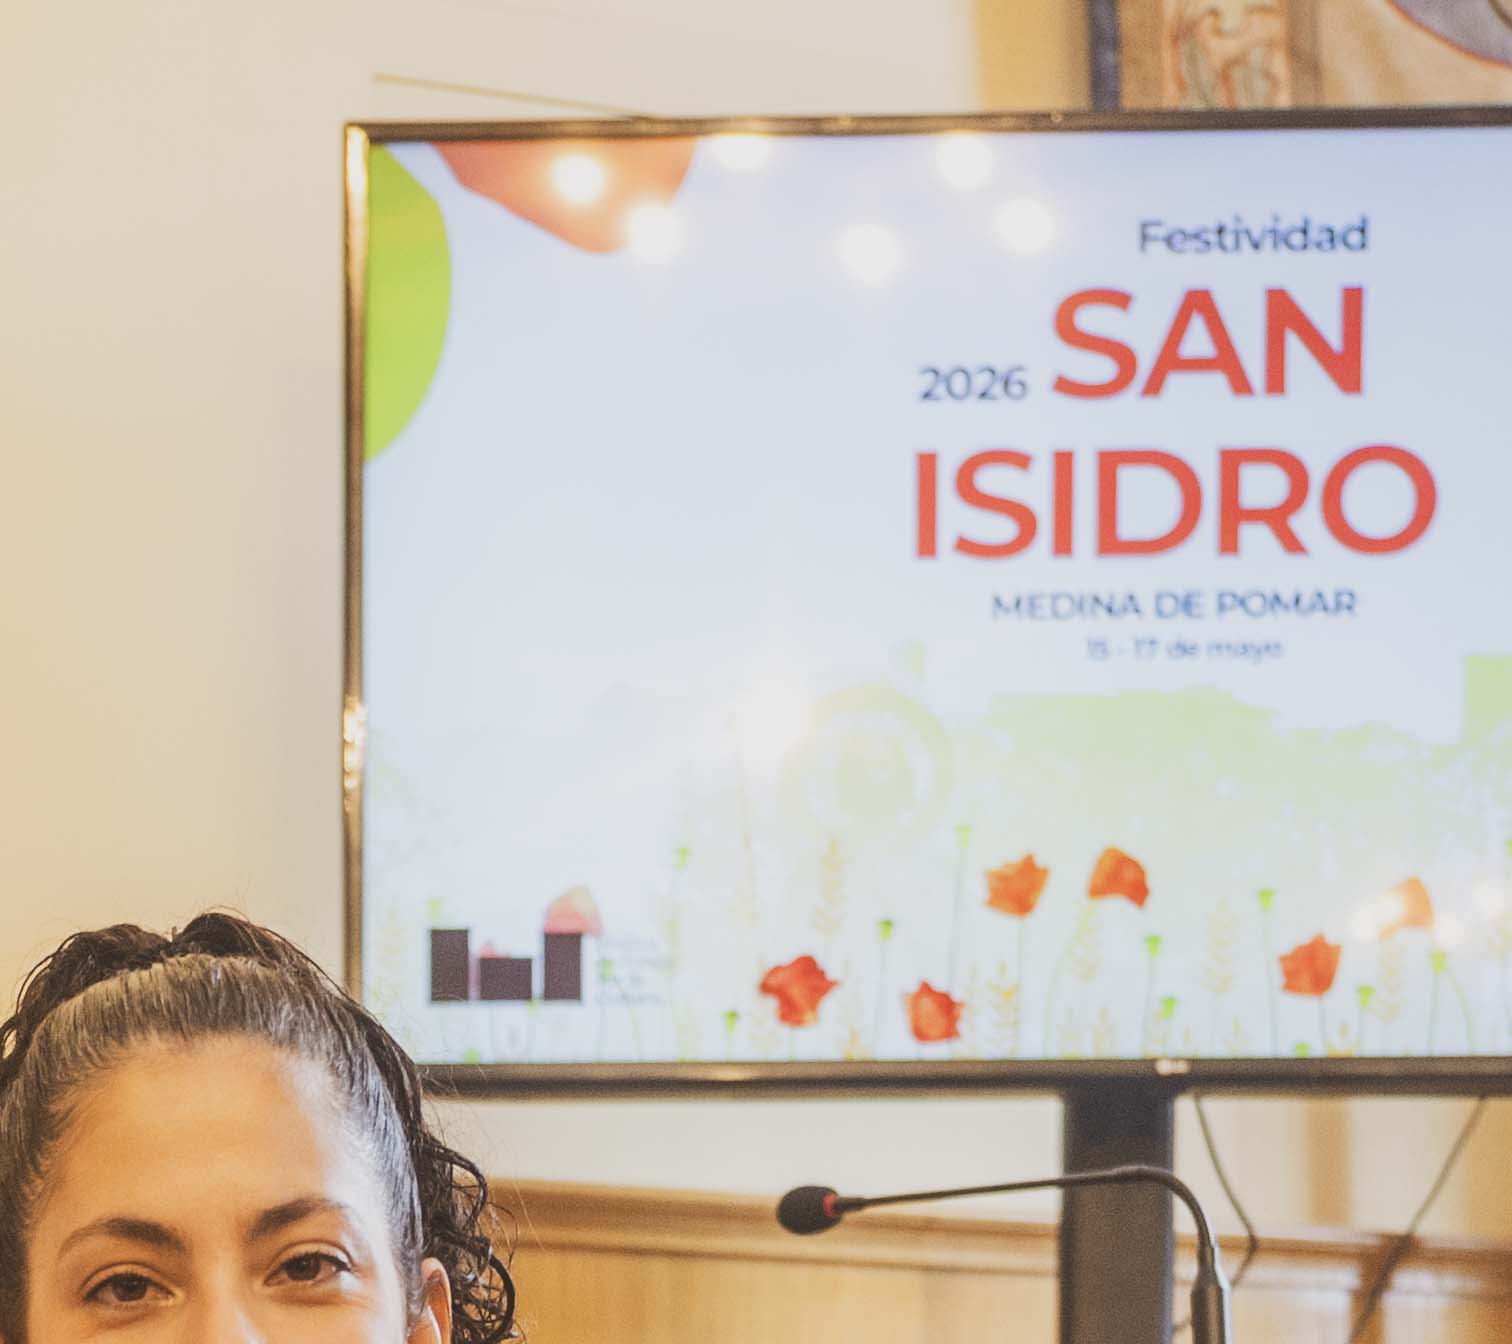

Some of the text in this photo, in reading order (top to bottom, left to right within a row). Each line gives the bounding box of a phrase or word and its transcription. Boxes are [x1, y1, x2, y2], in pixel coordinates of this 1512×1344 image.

[1139, 215, 1369, 253] Festividad
[919, 286, 1364, 401] 2026 SAN
[915, 445, 1437, 558] ISIDRO
[991, 589, 1358, 620] MEDINA DE POMAR
